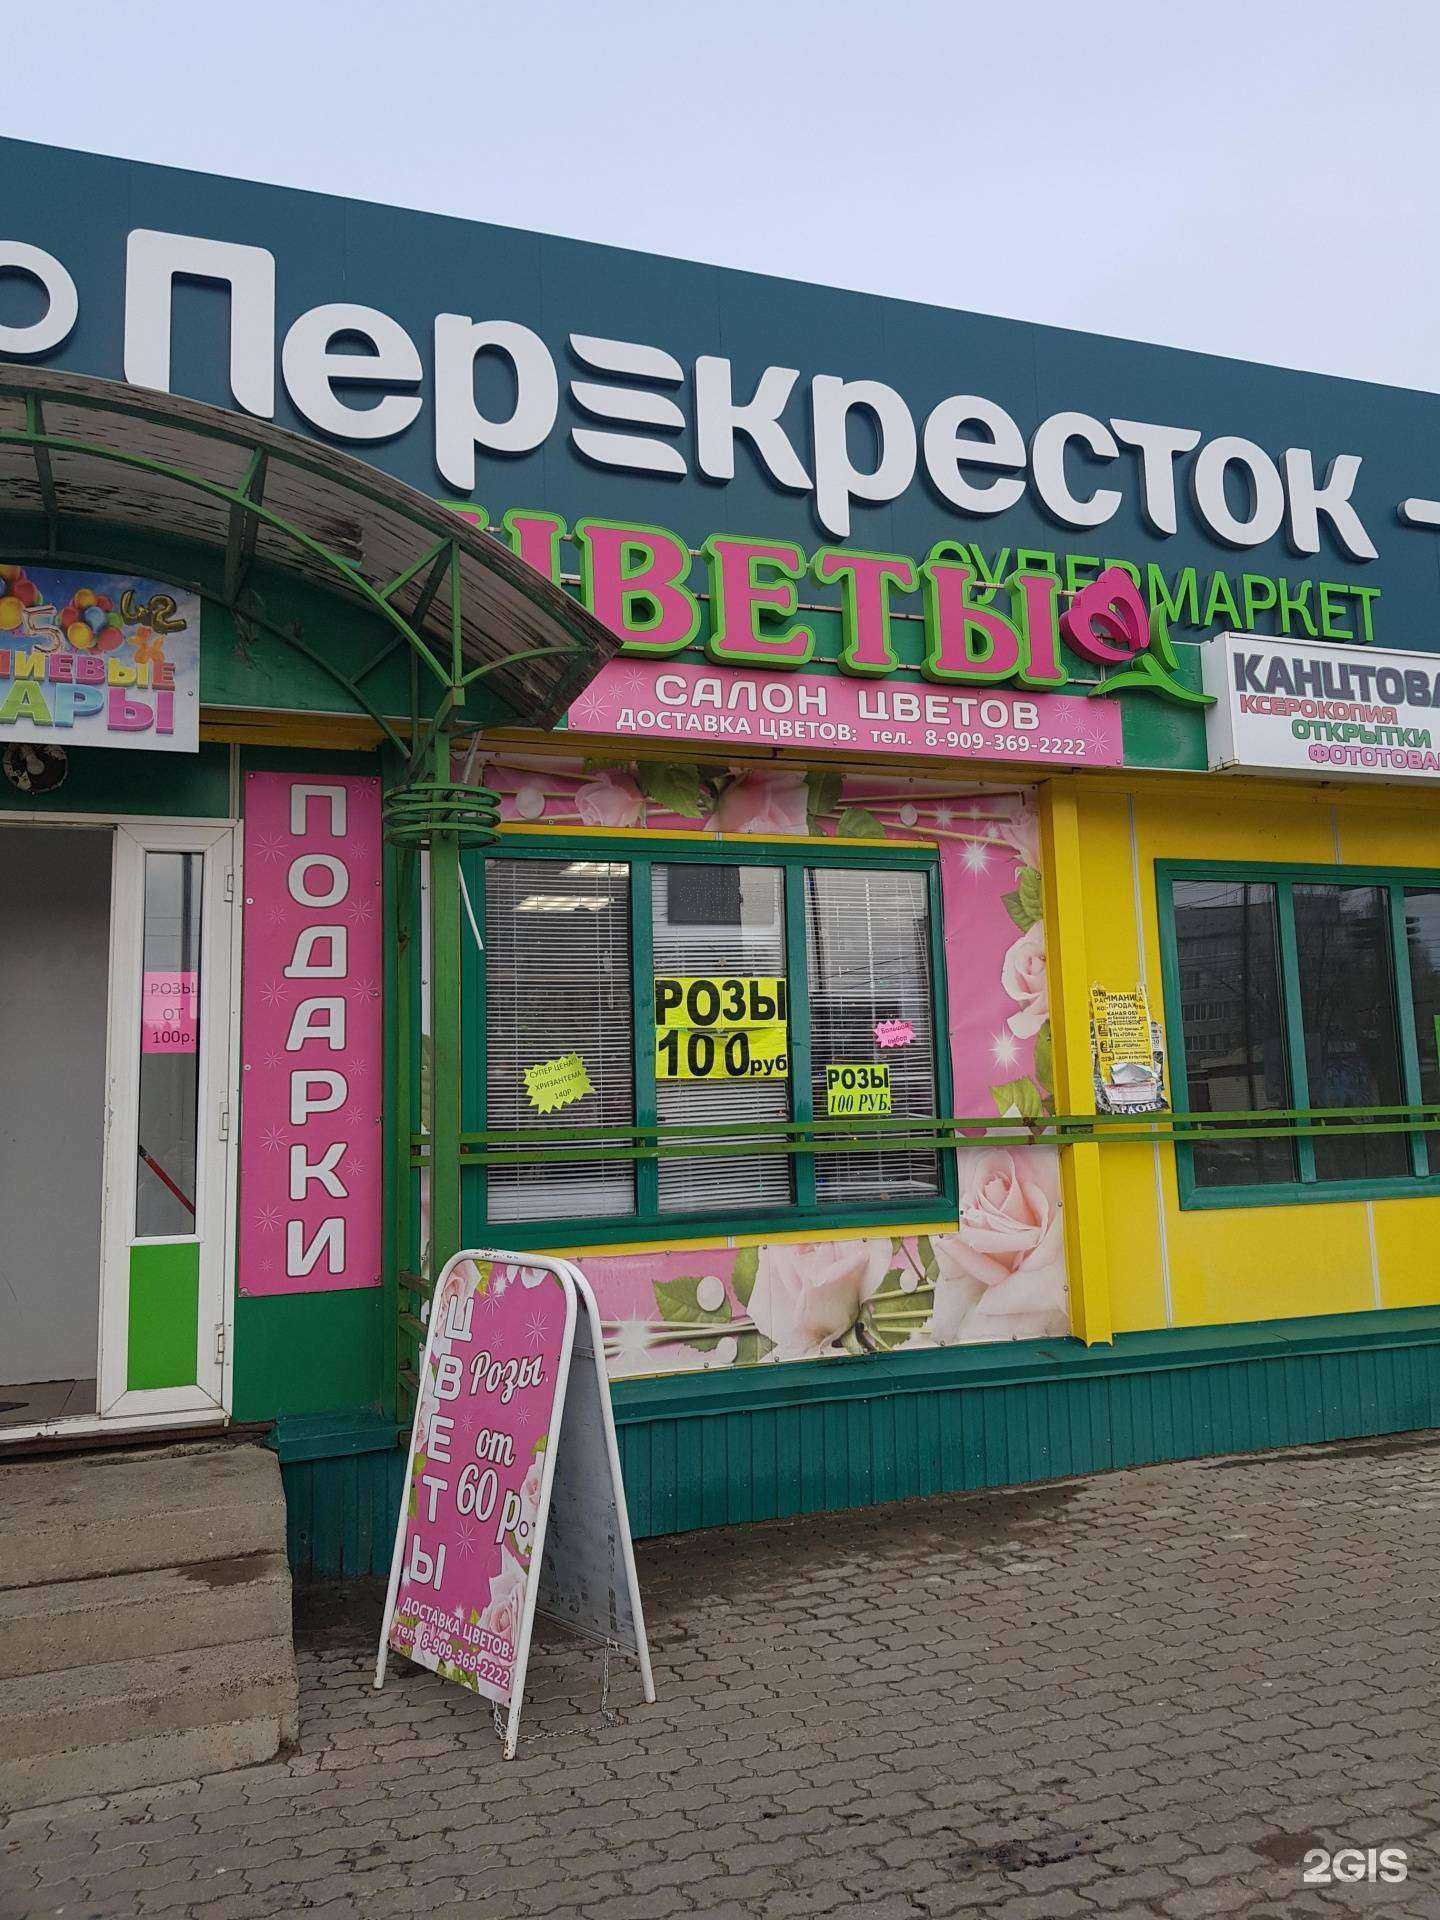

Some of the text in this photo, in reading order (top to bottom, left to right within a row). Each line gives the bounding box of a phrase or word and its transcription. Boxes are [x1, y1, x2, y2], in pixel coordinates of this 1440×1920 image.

[125, 228, 1378, 559] Перекресток
[655, 674, 1040, 730] САЛОН ЦВЕТОВ
[1240, 694, 1399, 725] КСЕРОКОПИЯ
[616, 708, 1087, 756] ДОСТАВКА ЦВЕТОВ: тел. 8-909-369-2222
[1291, 719, 1433, 748] ОТКРЫТКИ
[1308, 743, 1440, 771] ФОТОТОВА
[151, 981, 195, 994] РОЗЫ
[655, 979, 787, 1026] РОЗЫ
[163, 1007, 184, 1020] ОТ
[284, 783, 350, 1277] ПОДАРКИ
[153, 1030, 195, 1045] 100р.
[529, 1066, 553, 1079] СУПЕР
[535, 1070, 582, 1091] ХРИЗАНТЕМА
[827, 1068, 889, 1090] РОЗЫ
[830, 1094, 854, 1112] 100
[469, 1350, 545, 1404] Розы
[409, 1294, 475, 1592] ЦВЕТЫ
[475, 1428, 516, 1467] от
[456, 1463, 529, 1545] 60 р.
[401, 1597, 514, 1660] ДОСТАВКА ЦВЕТОВ:
[396, 1624, 512, 1689] тел. 8-909-369-2222
